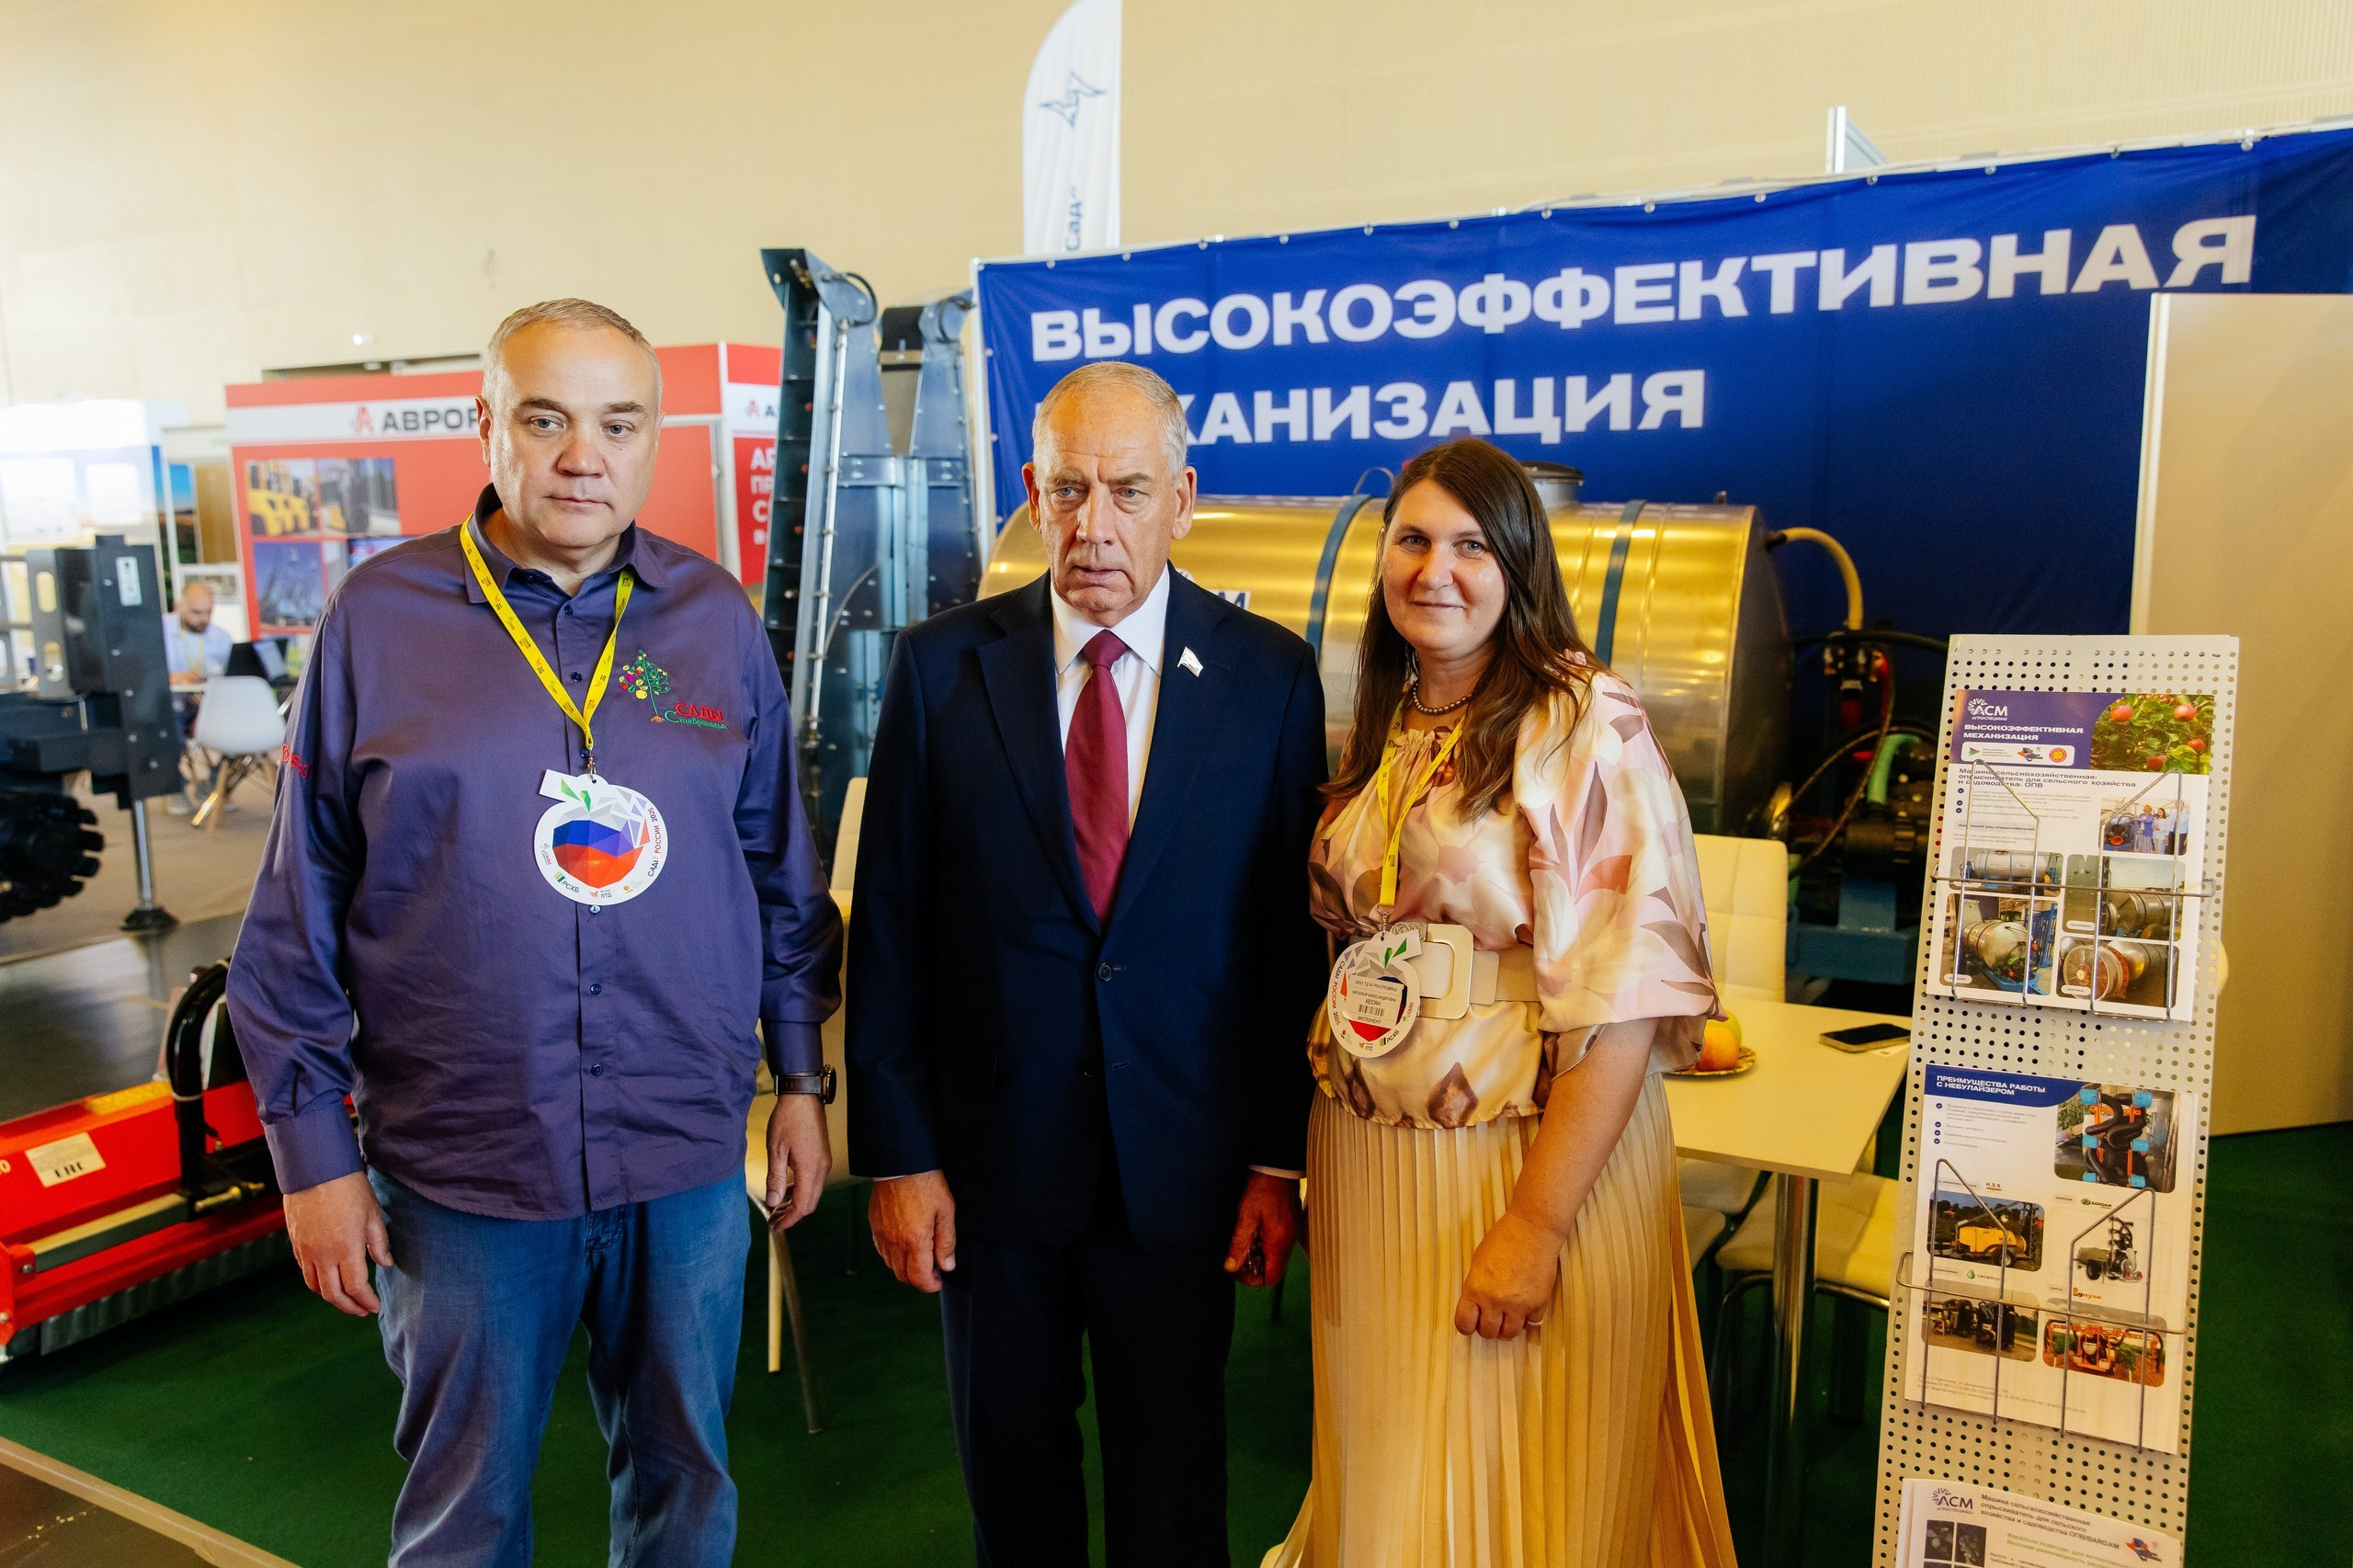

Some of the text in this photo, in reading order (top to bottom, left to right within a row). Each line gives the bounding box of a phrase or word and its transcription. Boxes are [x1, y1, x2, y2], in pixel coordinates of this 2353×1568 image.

[1030, 214, 2257, 362] ВЫСОКОЭФФЕКТИВНАЯ
[1178, 369, 1705, 446] АНИЗАЦИЯ
[675, 700, 723, 722] САДЫ
[1974, 705, 2008, 718] АСМ
[1962, 733, 2039, 742] МЕХАНИЗАЦИЯ
[1963, 724, 2084, 734] ВЫСОКОЭФФЕКТИВНАЯ
[1996, 770, 2098, 780] сельскохозяйственная:
[647, 807, 658, 823] 2025
[647, 856, 659, 878] САДЫ
[562, 880, 581, 893] РСХБ
[1936, 1074, 2046, 1093] ПРЕИМУЩЕСТВА РАБОТЫ
[1944, 1083, 2015, 1096] НЕБУЛАЙЗЕРОМ
[1938, 1495, 1973, 1509] АСМ
[1981, 1494, 2092, 1527] Машина сельскохозяйственная:
[1981, 1502, 2087, 1533] опрыскиватель для сельского
[1980, 1509, 2016, 1524] хозяйства
[2022, 1519, 2068, 1536] садоводства
[2068, 1530, 2120, 1550] ОПВ/BARGAM
